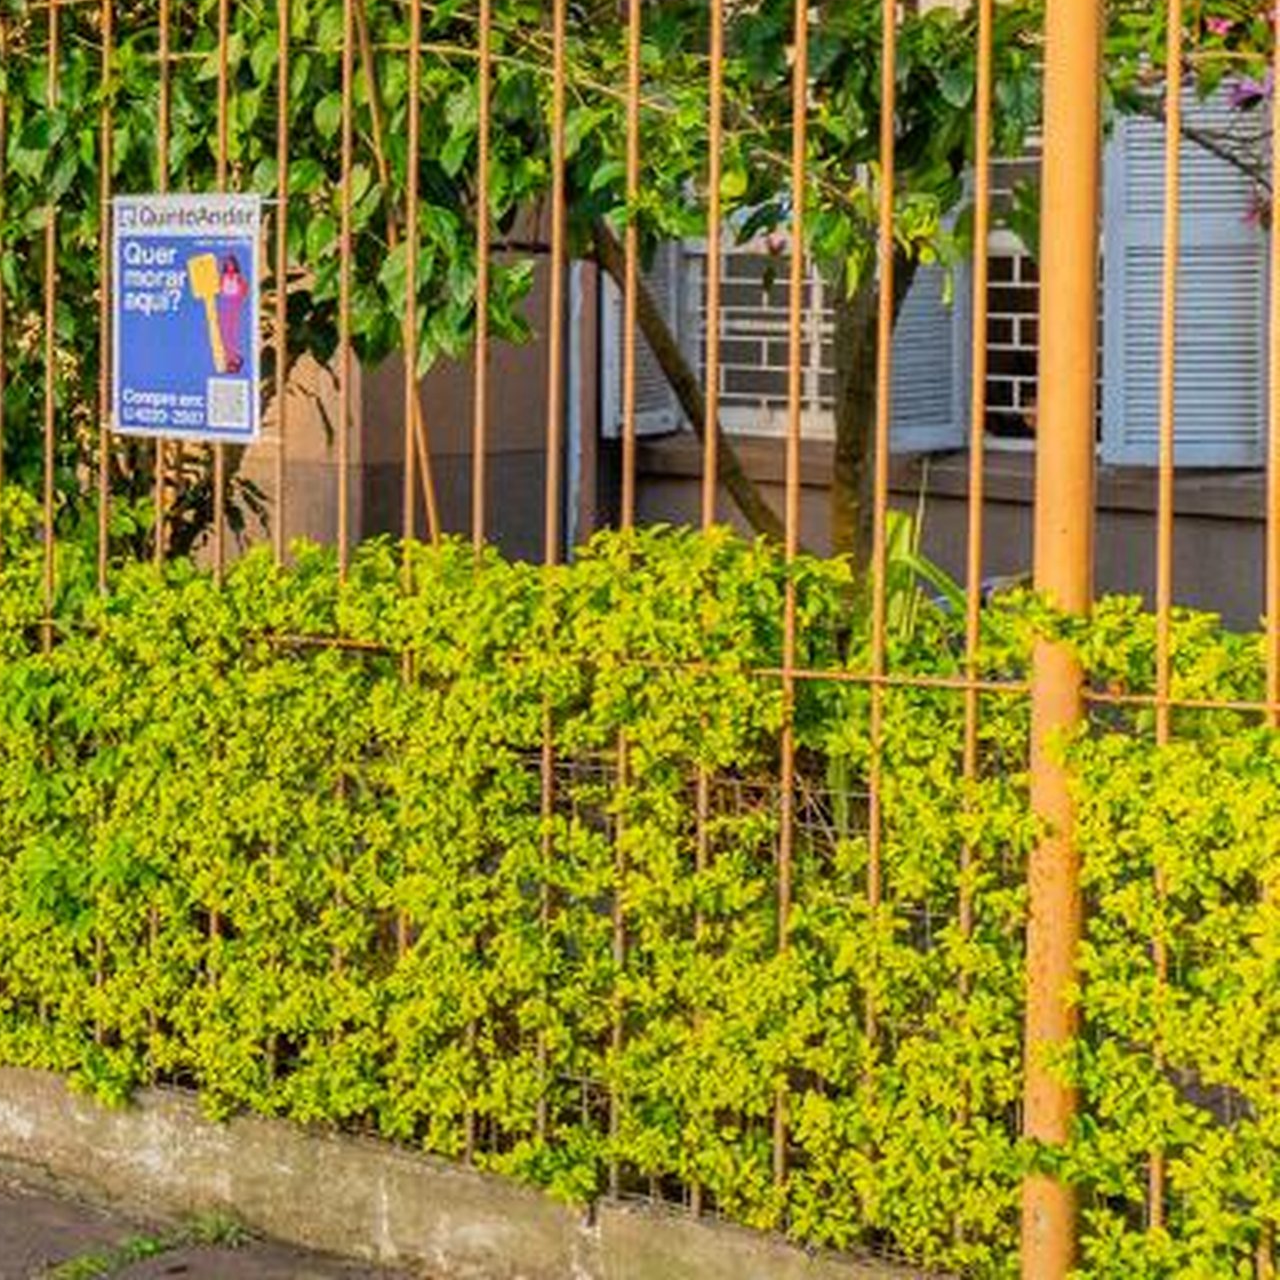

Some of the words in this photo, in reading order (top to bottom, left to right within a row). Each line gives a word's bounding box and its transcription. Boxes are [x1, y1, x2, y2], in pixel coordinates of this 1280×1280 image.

[124, 242, 177, 265] Quer
[124, 270, 188, 288] morar
[124, 290, 183, 315] aqui?
